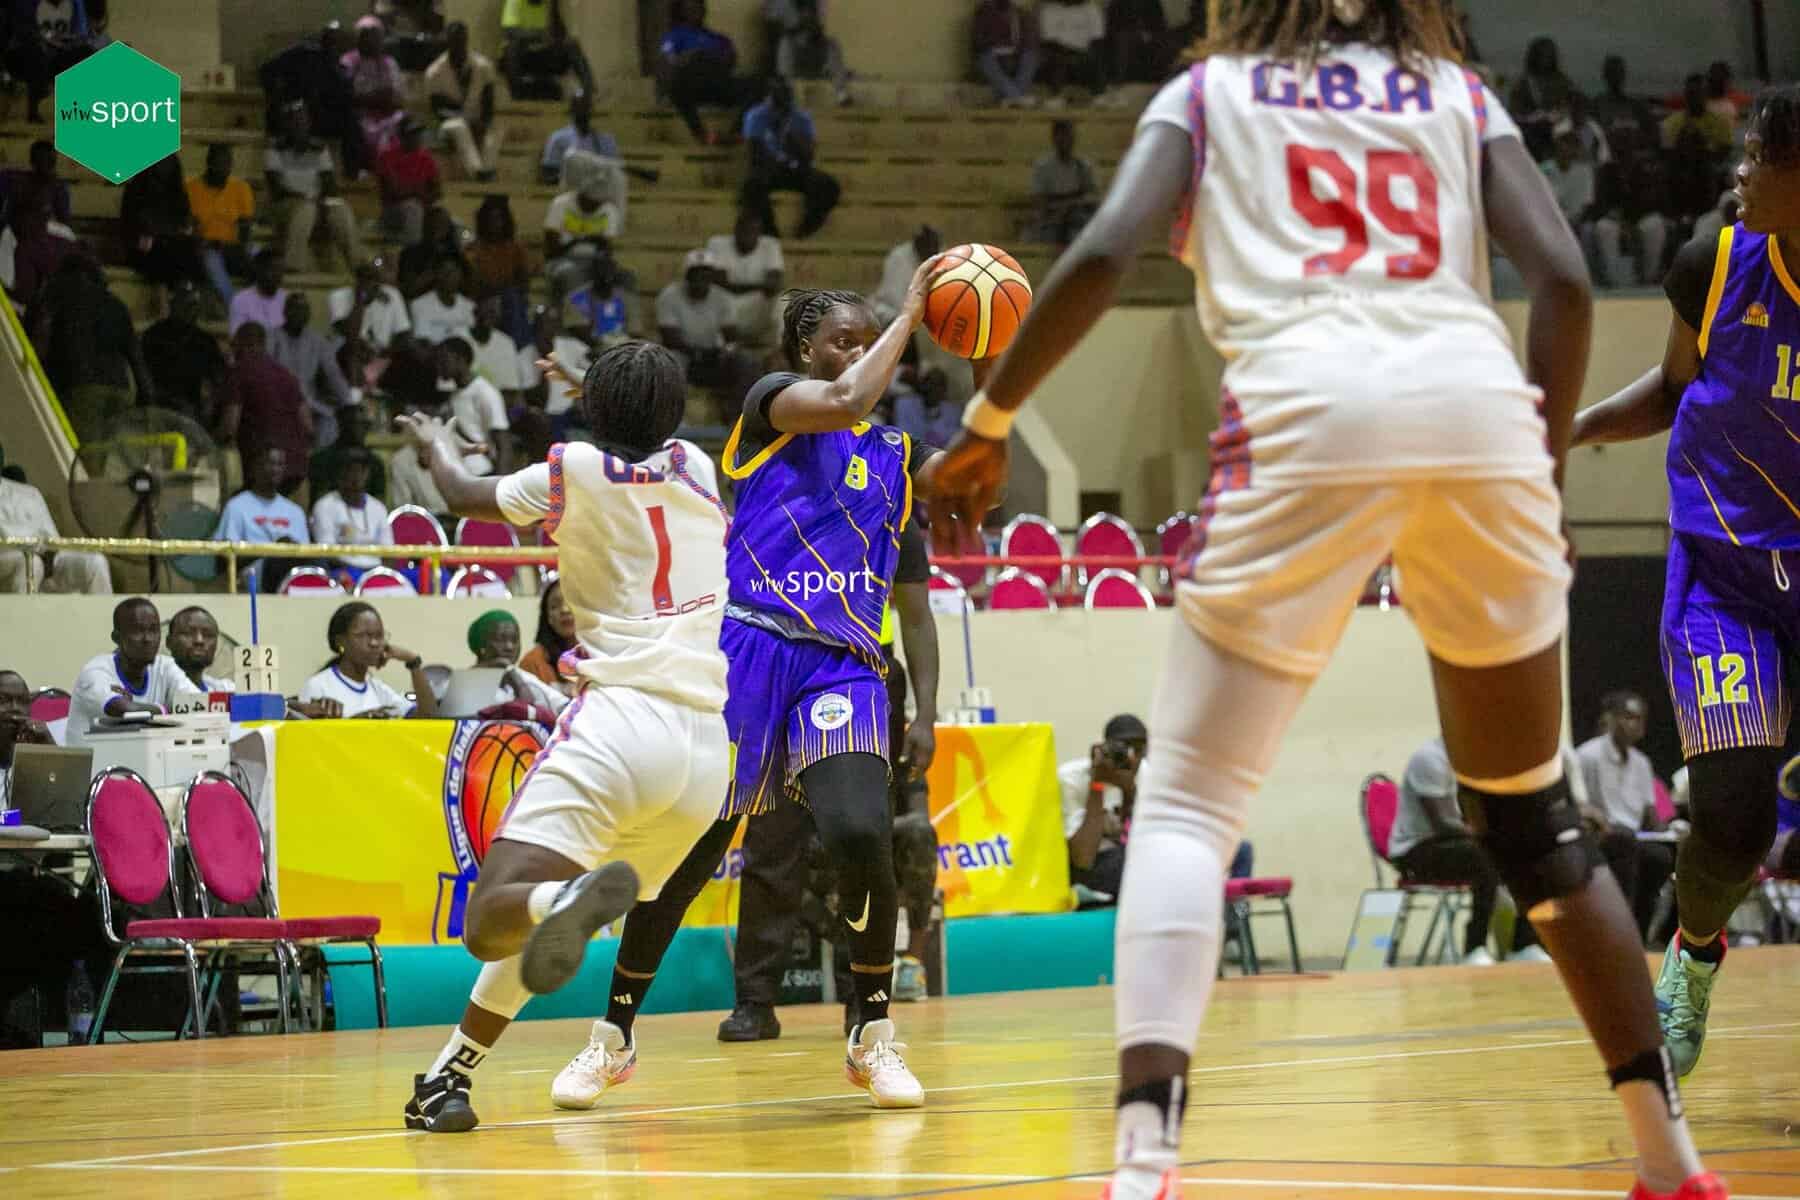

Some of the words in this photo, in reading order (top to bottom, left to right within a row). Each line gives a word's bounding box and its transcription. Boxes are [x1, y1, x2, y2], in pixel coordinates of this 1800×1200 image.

[1285, 143, 1441, 282] 99
[646, 505, 674, 609] 1
[1697, 653, 1749, 707] 12
[935, 833, 1013, 870] rant
